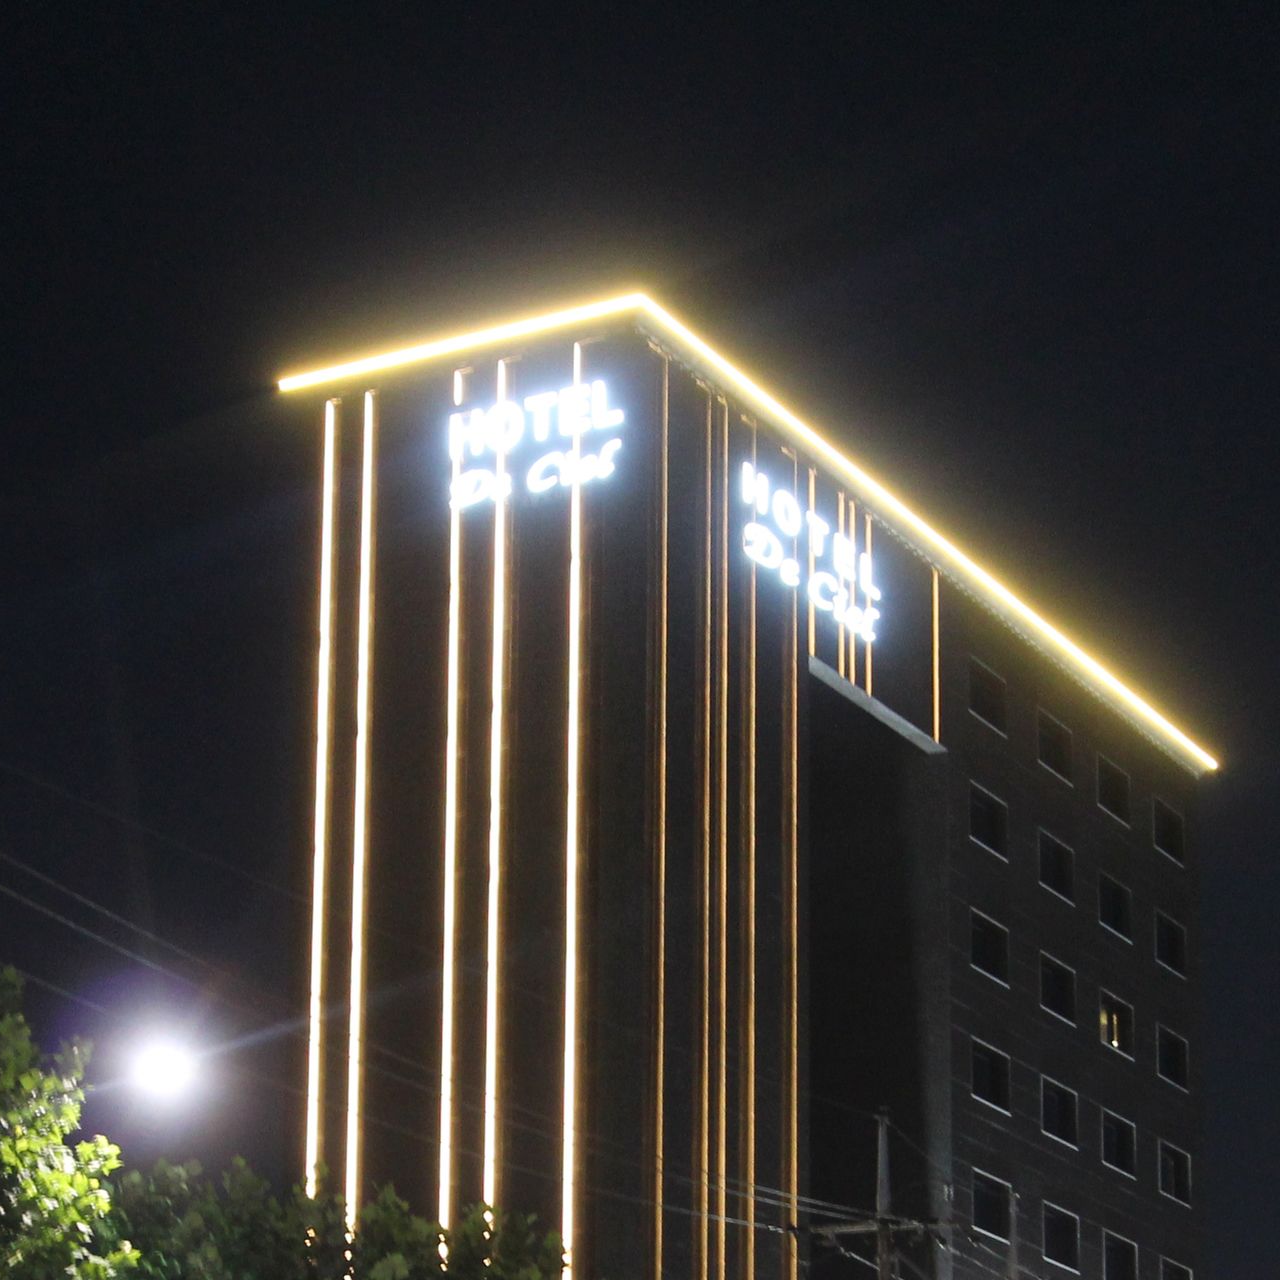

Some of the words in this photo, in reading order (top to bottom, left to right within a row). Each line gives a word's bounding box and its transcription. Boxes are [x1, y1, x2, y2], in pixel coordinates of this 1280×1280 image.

[449, 380, 624, 460] HOTEL
[450, 468, 512, 510] De
[742, 461, 881, 601] HOTEL
[743, 522, 800, 587] De
